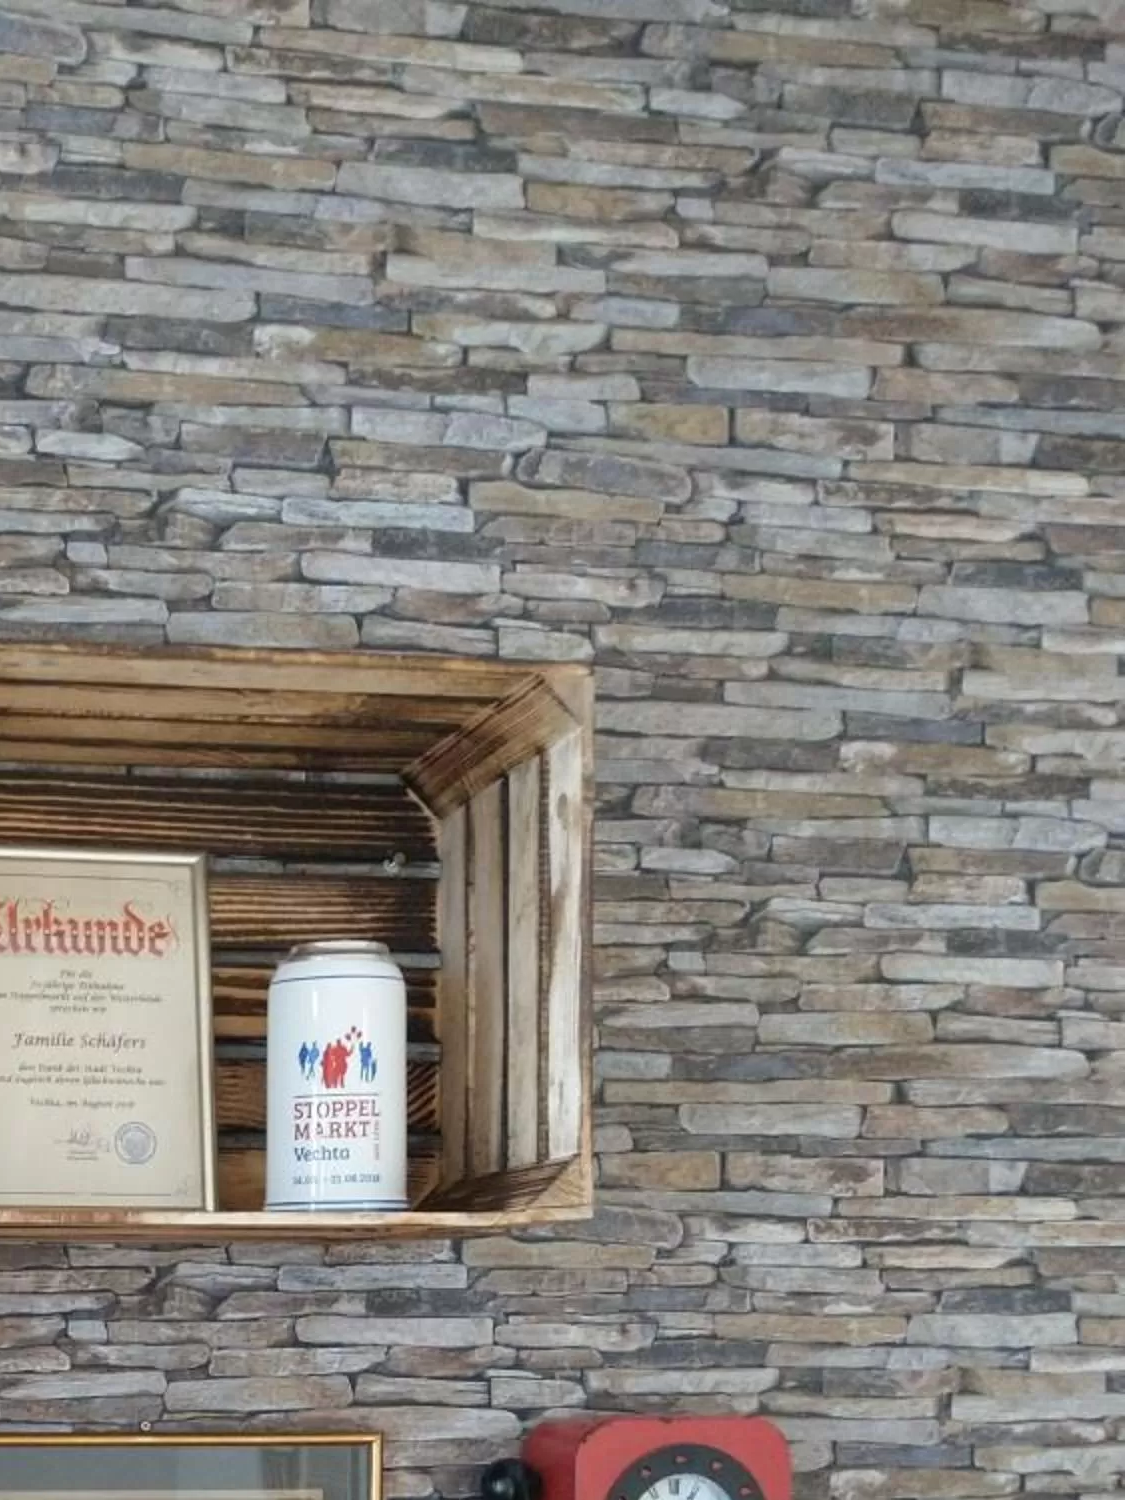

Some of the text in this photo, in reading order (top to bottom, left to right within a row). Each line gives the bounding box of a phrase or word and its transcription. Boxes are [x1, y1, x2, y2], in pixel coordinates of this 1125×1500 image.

[11, 1030, 75, 1050] Familie
[293, 1099, 380, 1120] STOPPEL
[294, 1121, 371, 1141] MARKT
